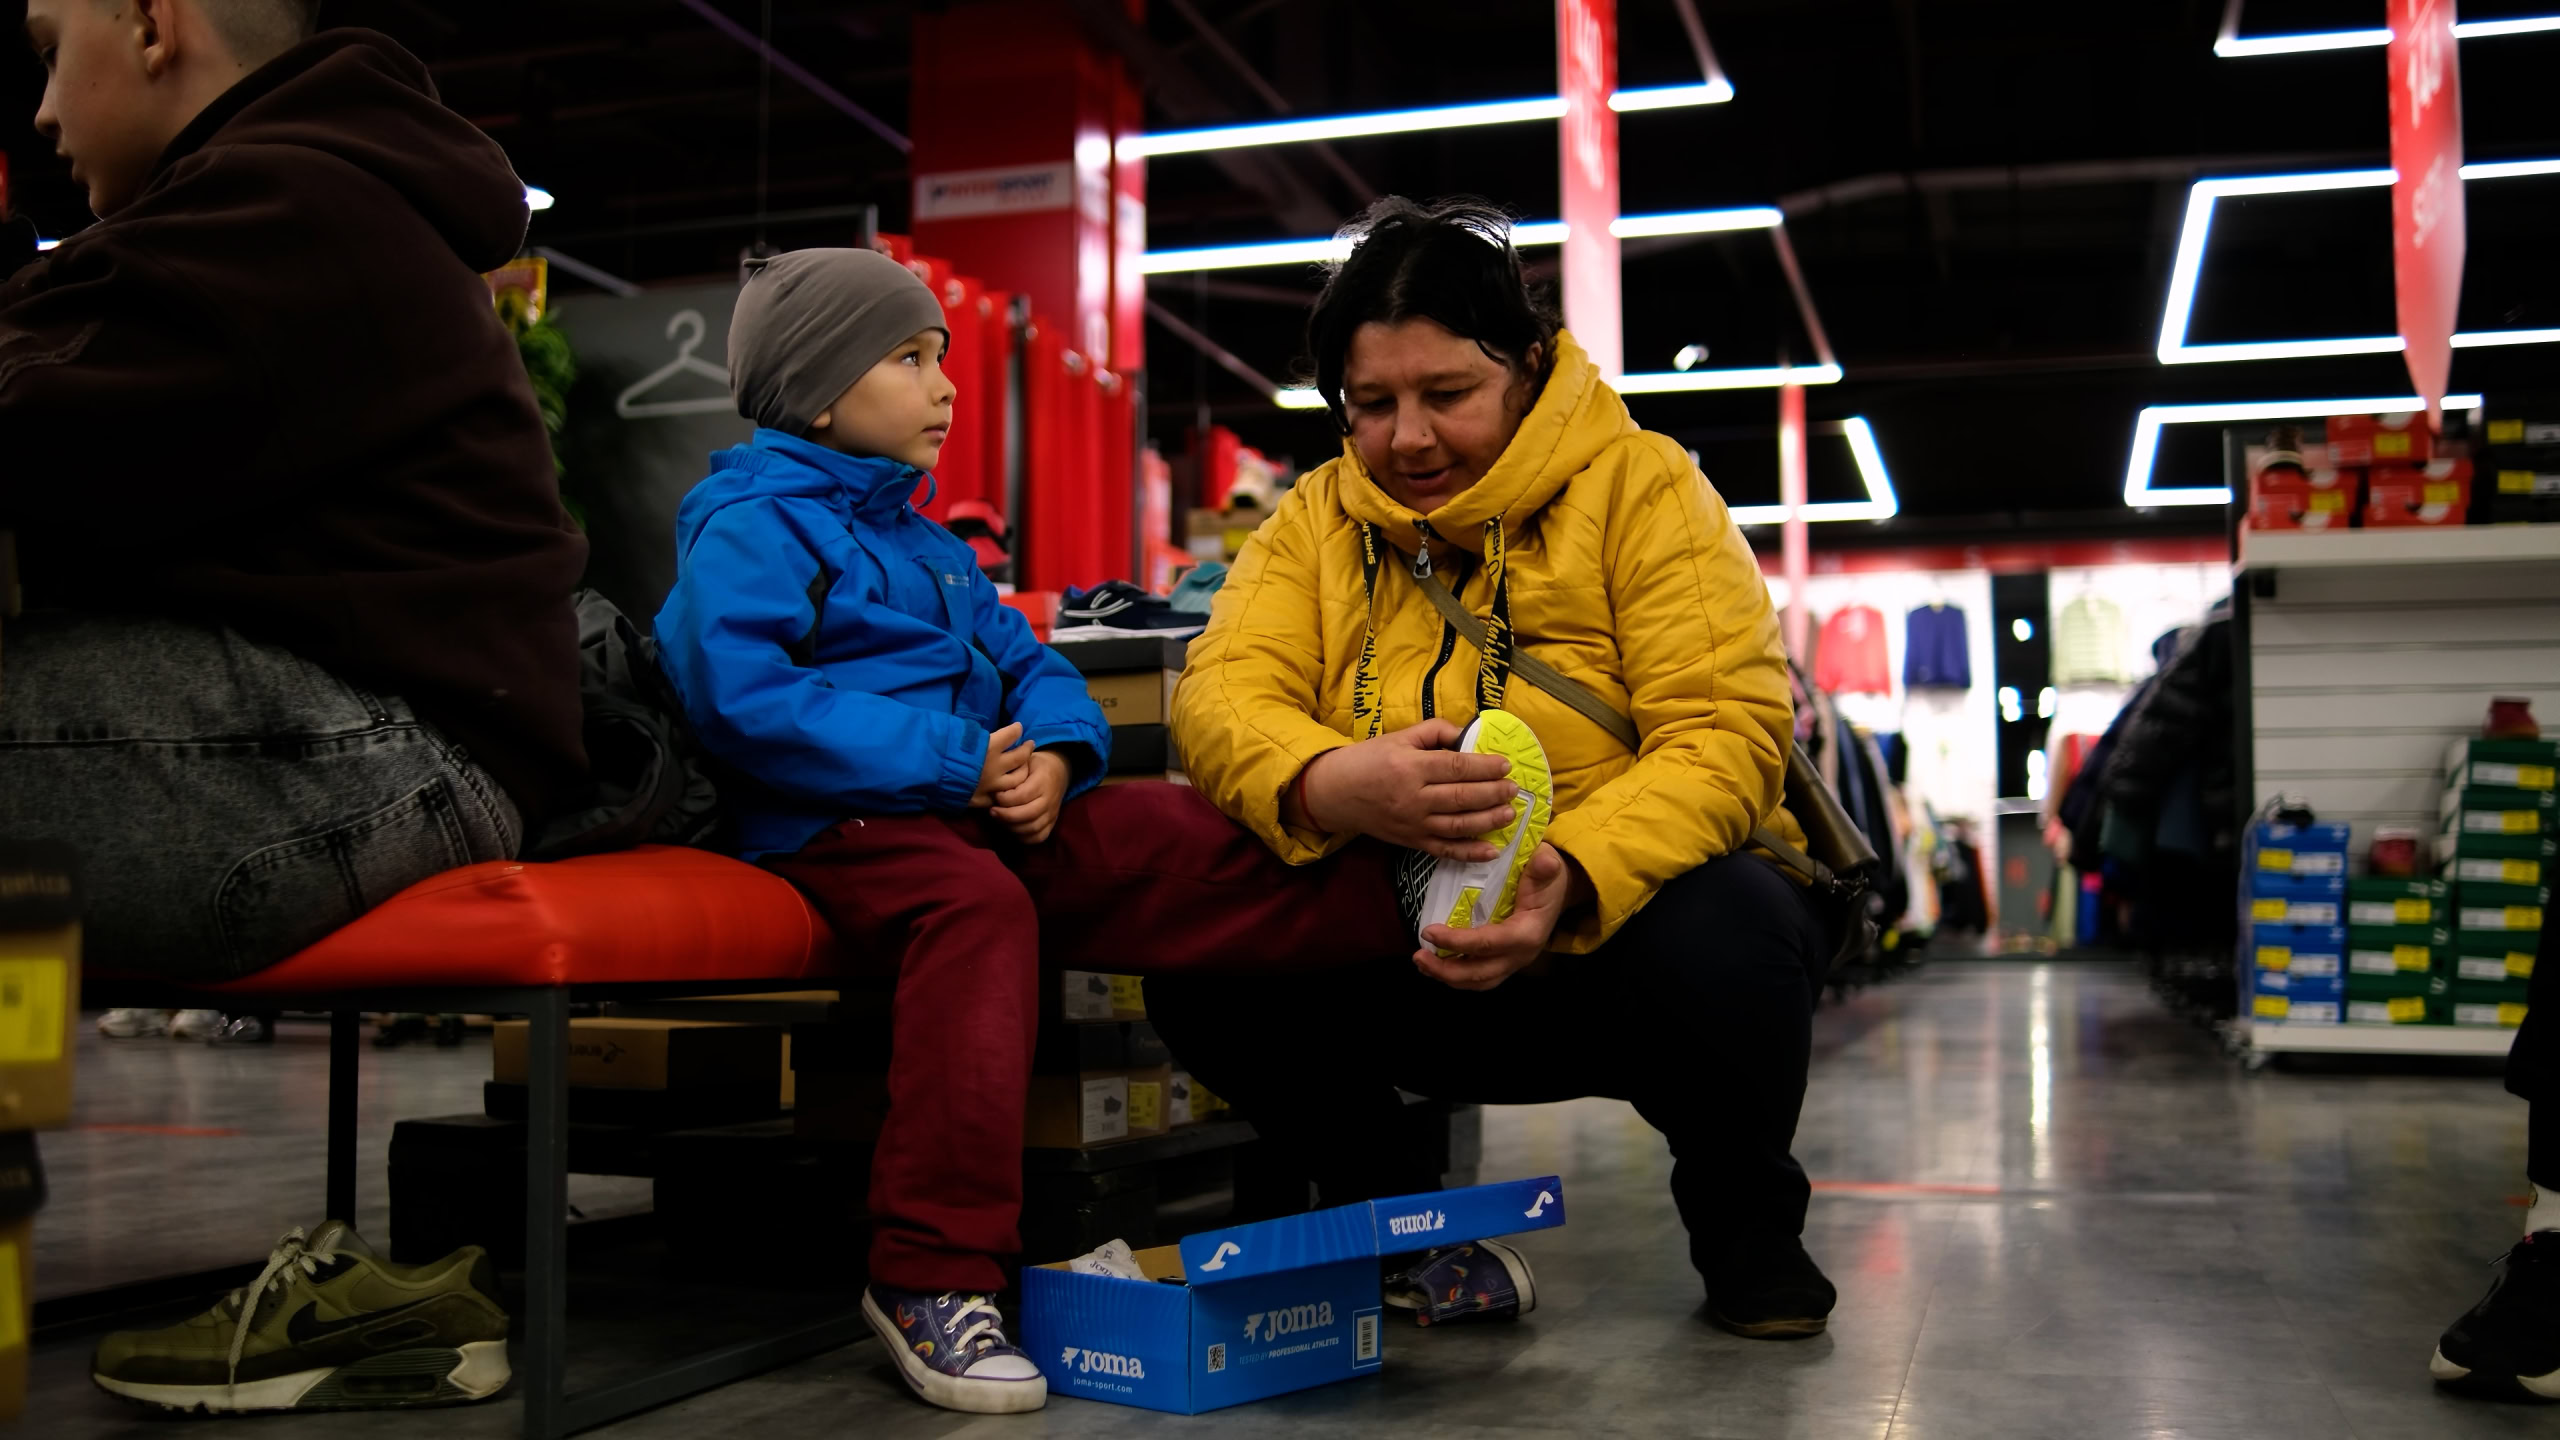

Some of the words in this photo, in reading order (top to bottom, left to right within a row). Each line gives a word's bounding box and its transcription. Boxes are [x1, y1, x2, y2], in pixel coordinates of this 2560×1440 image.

[1389, 1210, 1434, 1236] Joma
[1264, 1301, 1335, 1342] Joma
[1079, 1349, 1145, 1379] Joma
[1240, 1353, 1260, 1365] TESTED
[1268, 1343, 1311, 1359] PROFESSIONAL
[1311, 1337, 1340, 1350] ATHLETES
[1073, 1376, 1133, 1394] joma-sport.com
